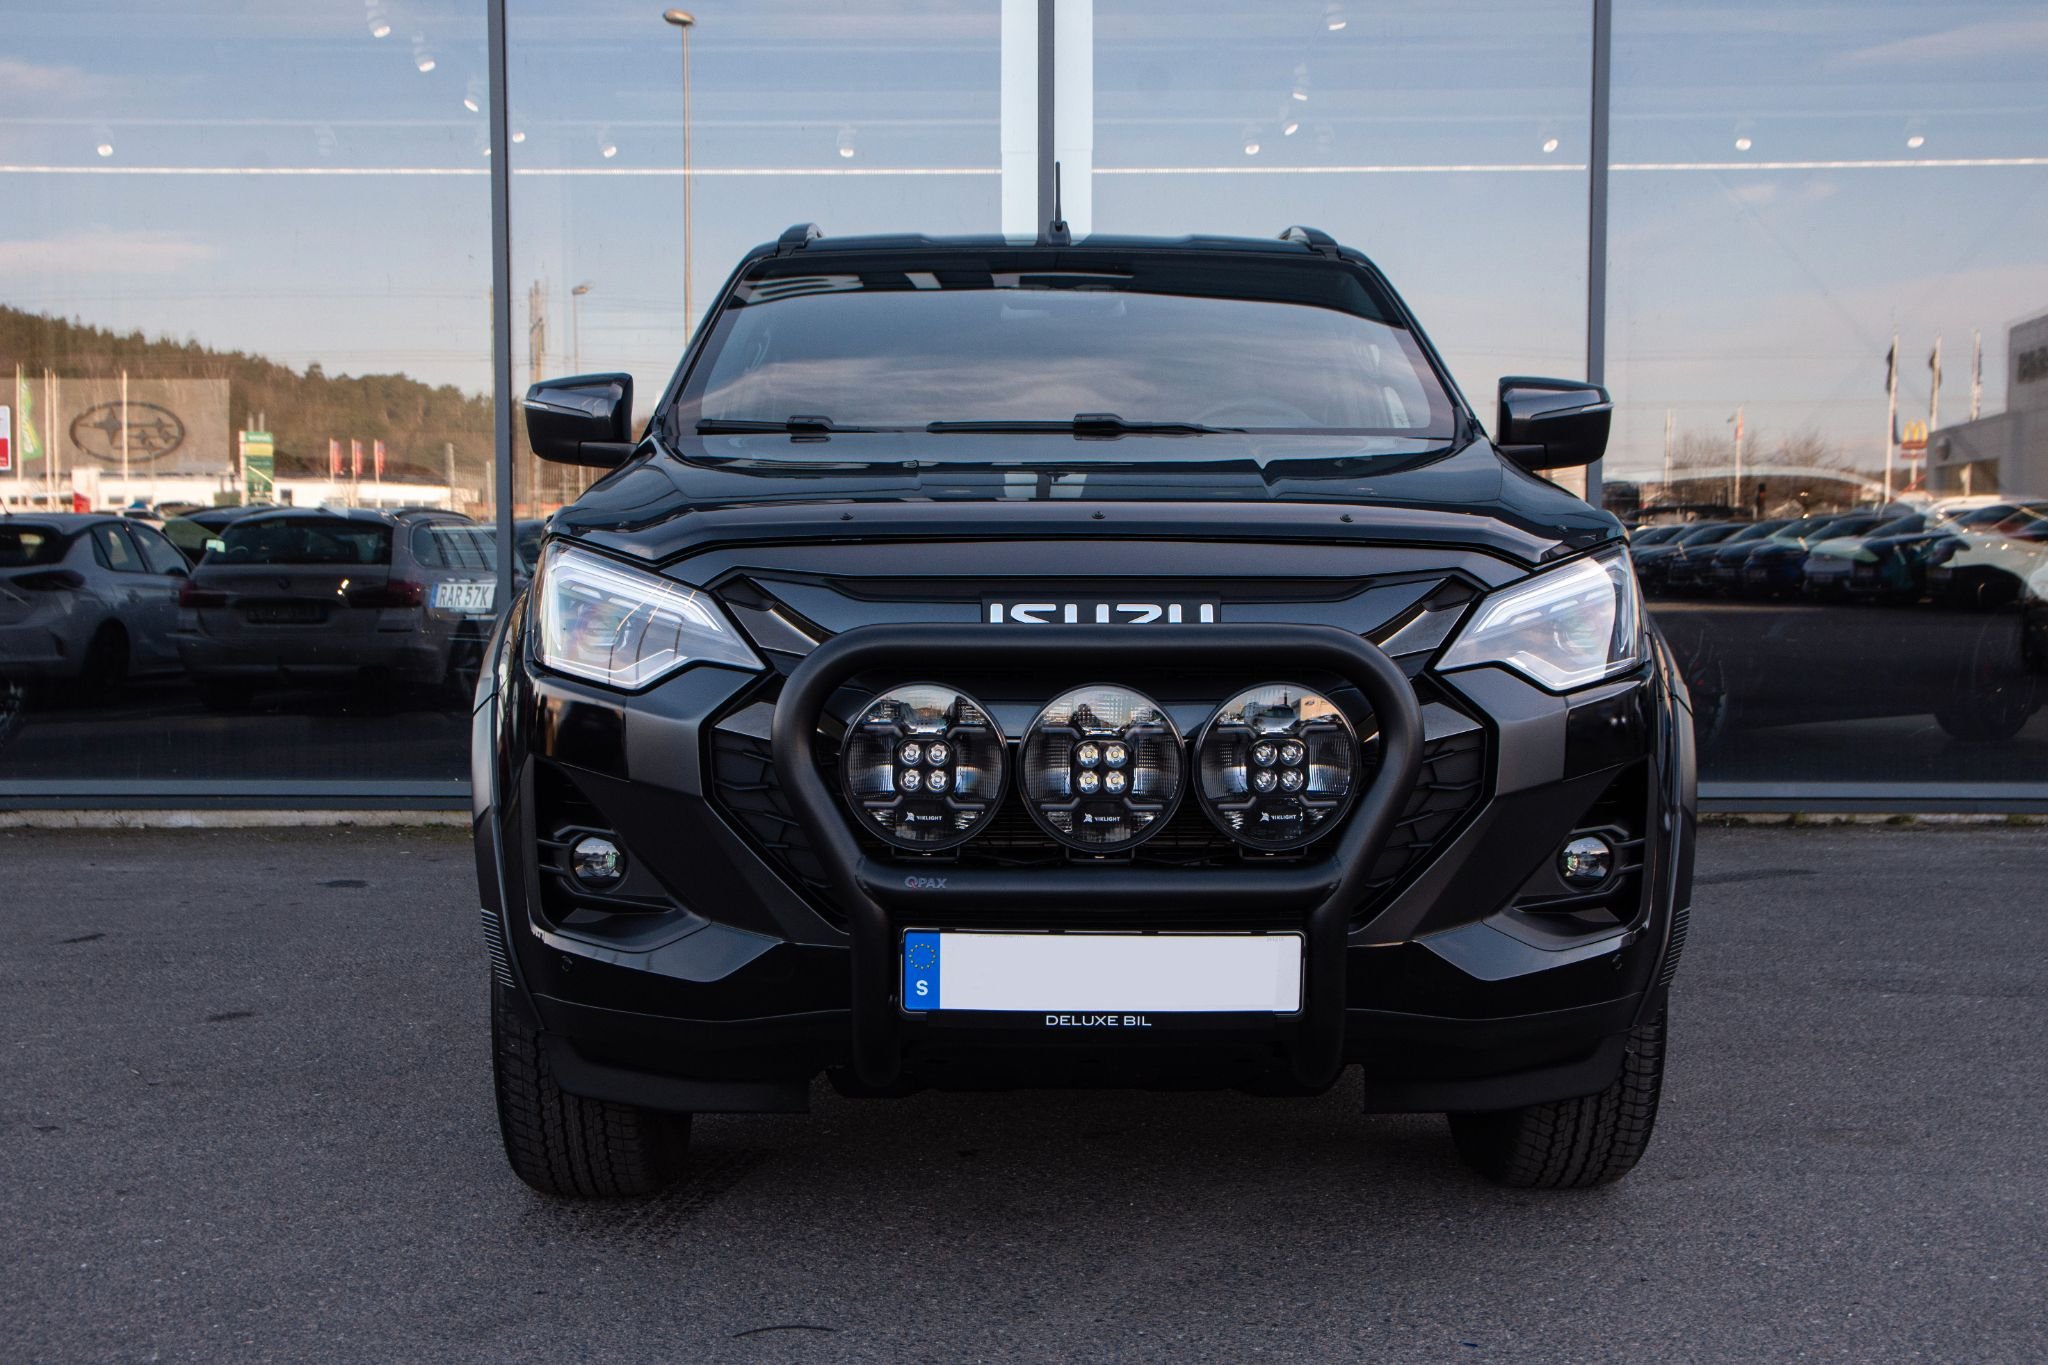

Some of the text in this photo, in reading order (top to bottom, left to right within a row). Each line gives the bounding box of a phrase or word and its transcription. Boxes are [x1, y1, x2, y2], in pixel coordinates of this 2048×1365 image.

[440, 586, 489, 606] RAR 57K
[904, 876, 947, 889] QPAX
[916, 979, 929, 996] S
[1045, 1015, 1152, 1026] DELUXE BIL
